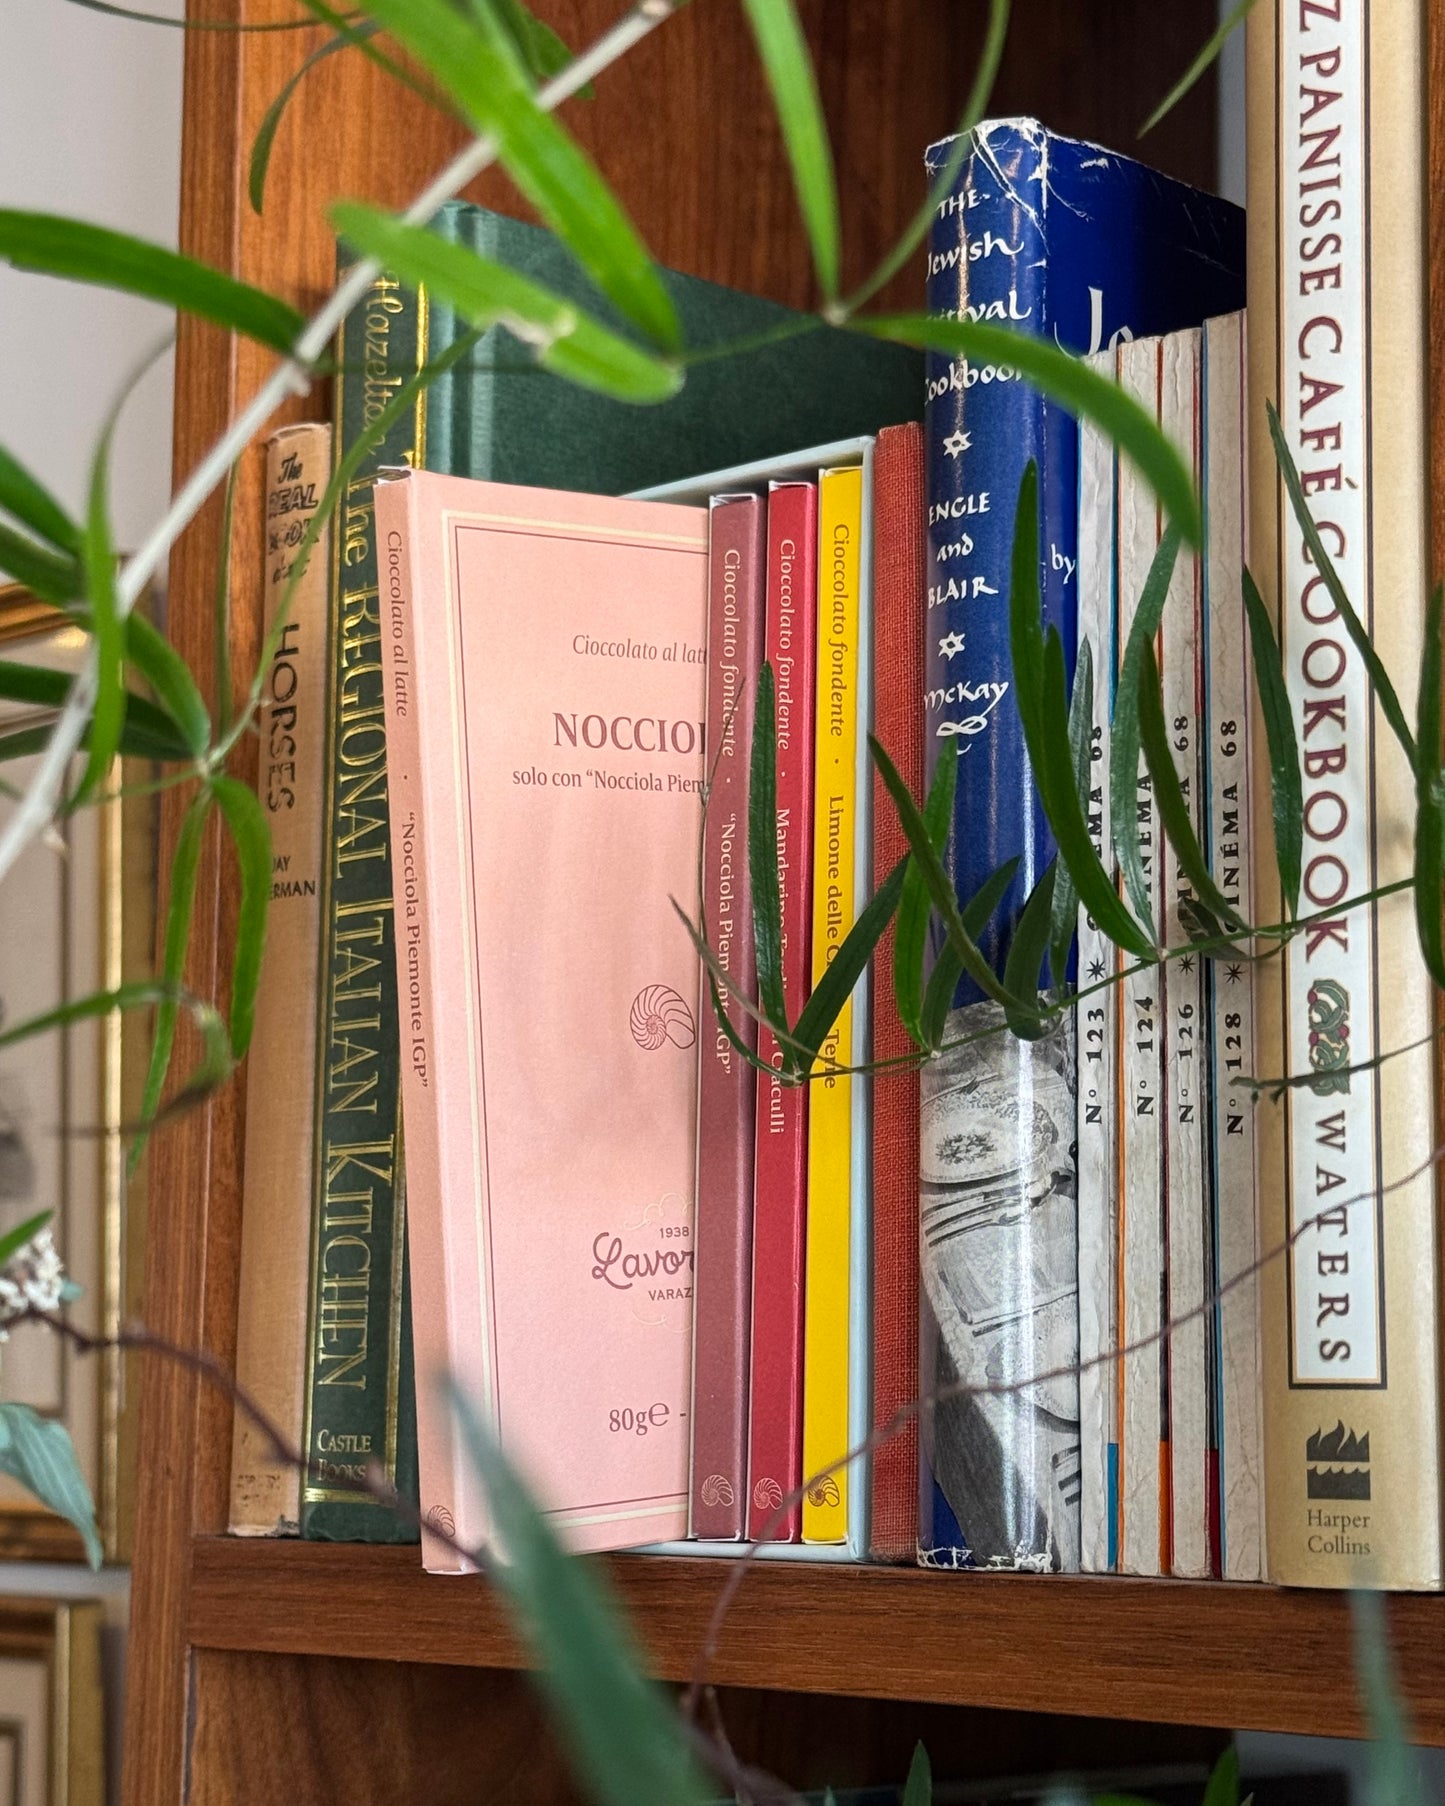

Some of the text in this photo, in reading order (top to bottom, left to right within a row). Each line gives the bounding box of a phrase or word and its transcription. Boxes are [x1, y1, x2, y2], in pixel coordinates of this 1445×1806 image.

[1298, 46, 1343, 297] PANISSE
[937, 189, 978, 220] THE
[926, 231, 1025, 283] Jewish
[925, 358, 1023, 406] ookboo
[1298, 316, 1358, 498] CAFÉ
[278, 452, 304, 484] The
[928, 492, 991, 527] ENGLE
[937, 532, 974, 562] and
[1051, 543, 1076, 584] by
[386, 530, 406, 640] Cioccolato
[723, 549, 741, 659] Cioccolato
[779, 538, 797, 650] Cioccolato
[834, 524, 850, 636] Cioccolato
[928, 576, 999, 610] BLAIR
[394, 643, 409, 665] al
[573, 634, 658, 661] Cioccolato
[662, 642, 678, 663] al
[394, 670, 410, 717] latte
[719, 661, 740, 758] fondente
[775, 652, 795, 751] fondente
[829, 639, 849, 737] fondente
[268, 622, 300, 813] HORSES
[336, 583, 392, 882] REGIONAL
[1174, 716, 1189, 751] 68
[1221, 720, 1237, 757] 68
[1301, 520, 1348, 964] COOKBOOK
[512, 767, 547, 786] solo
[552, 771, 582, 788] con
[828, 796, 844, 880] Limone
[271, 881, 316, 901] RMAN
[827, 885, 843, 939] delle
[328, 896, 395, 1114] ITALIAN
[407, 923, 423, 1031] Piemonte
[1086, 1008, 1104, 1063] 123
[1135, 996, 1153, 1053] 124
[1178, 1003, 1194, 1061] 126
[1225, 1013, 1242, 1071] 128
[770, 1051, 785, 1134] Caculli
[659, 1226, 690, 1239] 1938
[1315, 1110, 1351, 1363] WATERS
[317, 1133, 395, 1391] KITCHEN
[1307, 1508, 1371, 1534] Harper
[1307, 1534, 1371, 1555] Collins
